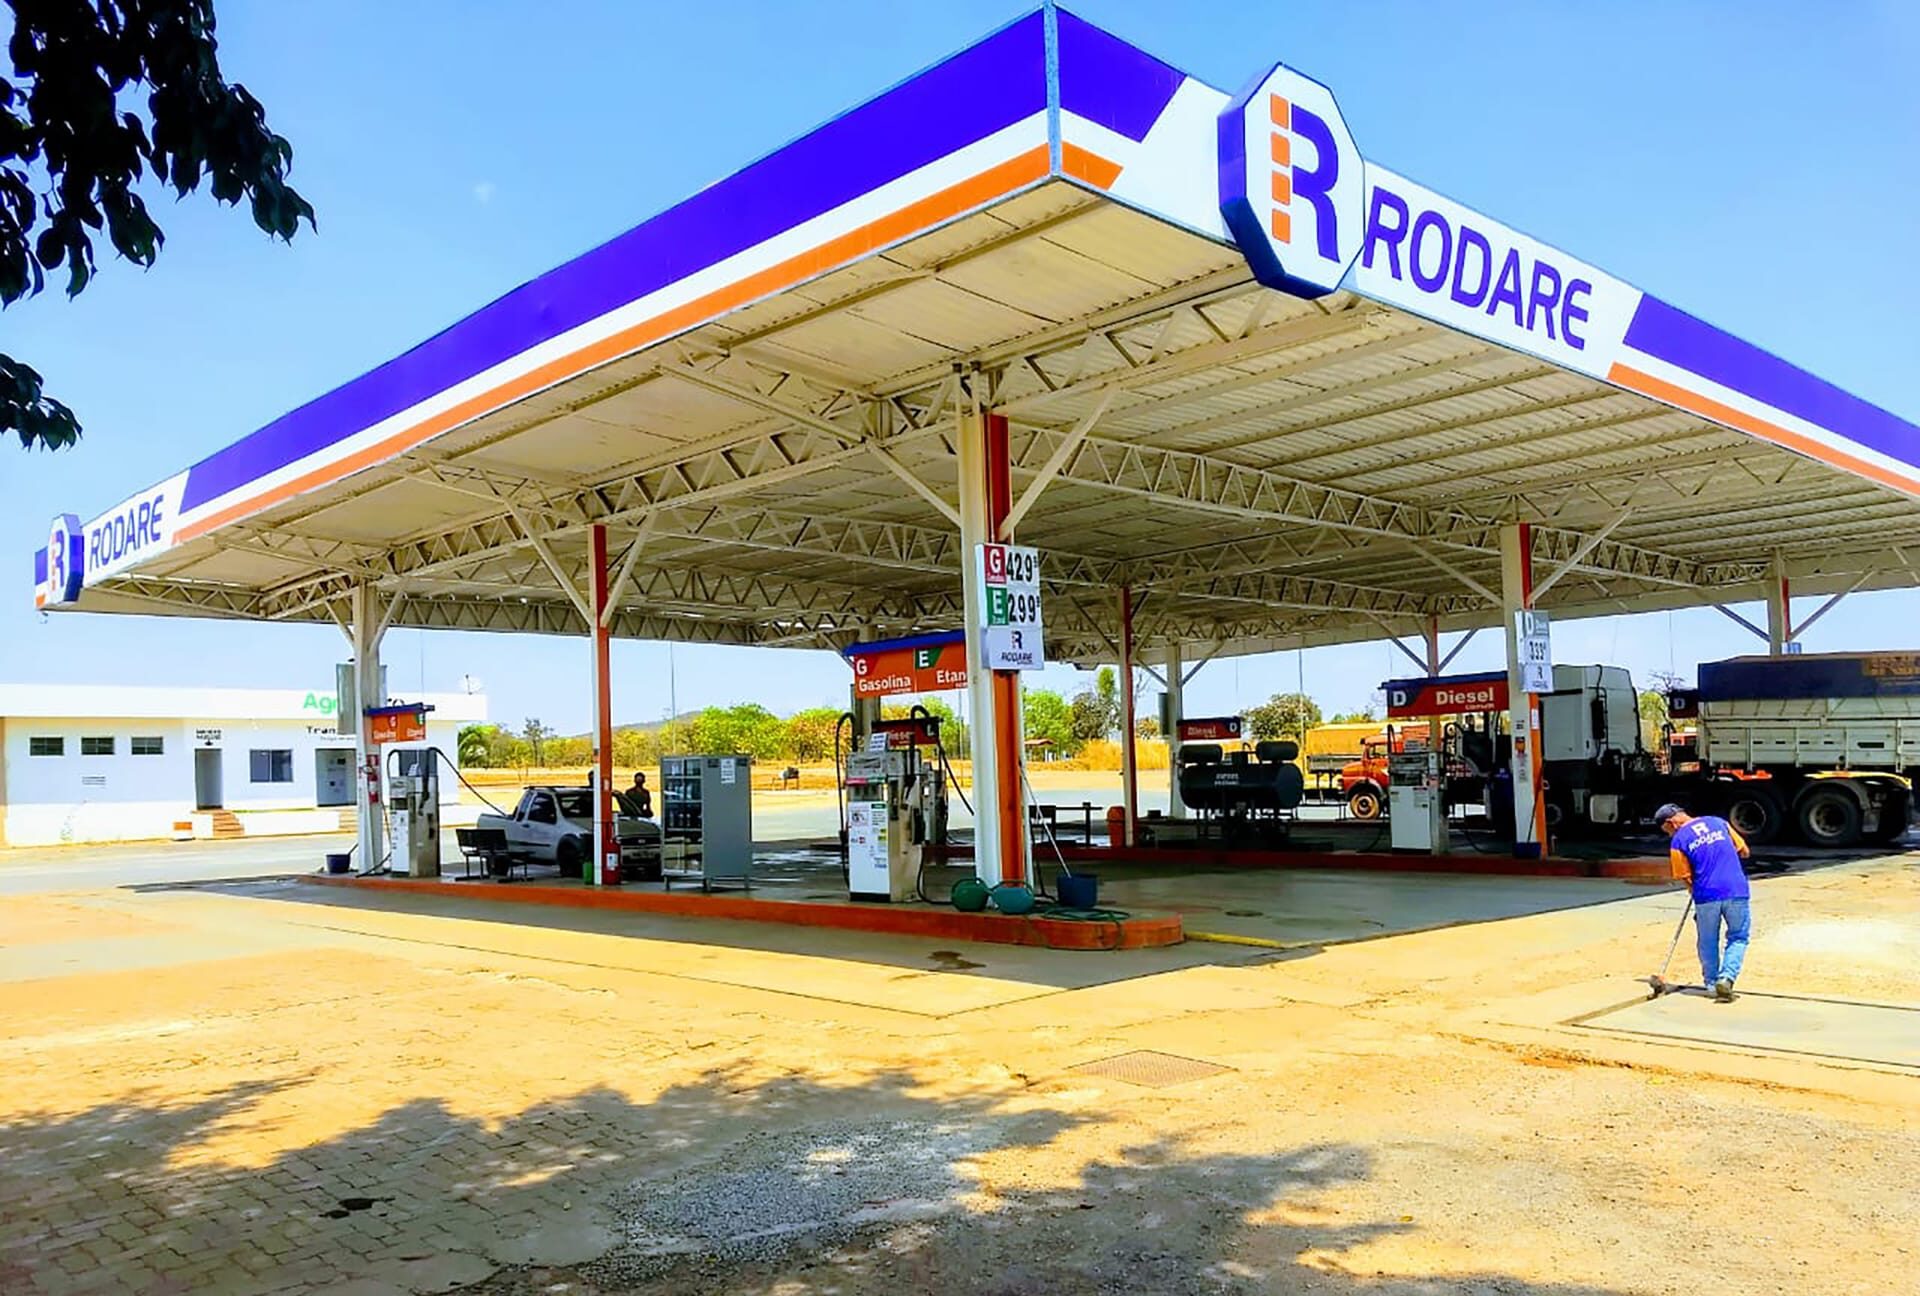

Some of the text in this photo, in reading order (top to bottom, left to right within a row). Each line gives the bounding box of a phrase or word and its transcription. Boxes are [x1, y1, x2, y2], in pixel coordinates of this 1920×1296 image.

[1270, 92, 1341, 264] R
[1361, 185, 1592, 351] RODARE
[88, 494, 164, 572] RODARE
[51, 529, 65, 592] R
[989, 548, 1002, 574] G
[992, 590, 1002, 614] E
[1011, 630, 1023, 650] R
[856, 659, 868, 676] G
[918, 649, 930, 668] E
[858, 673, 912, 692] Gasolina
[1392, 687, 1494, 707] D Diesel
